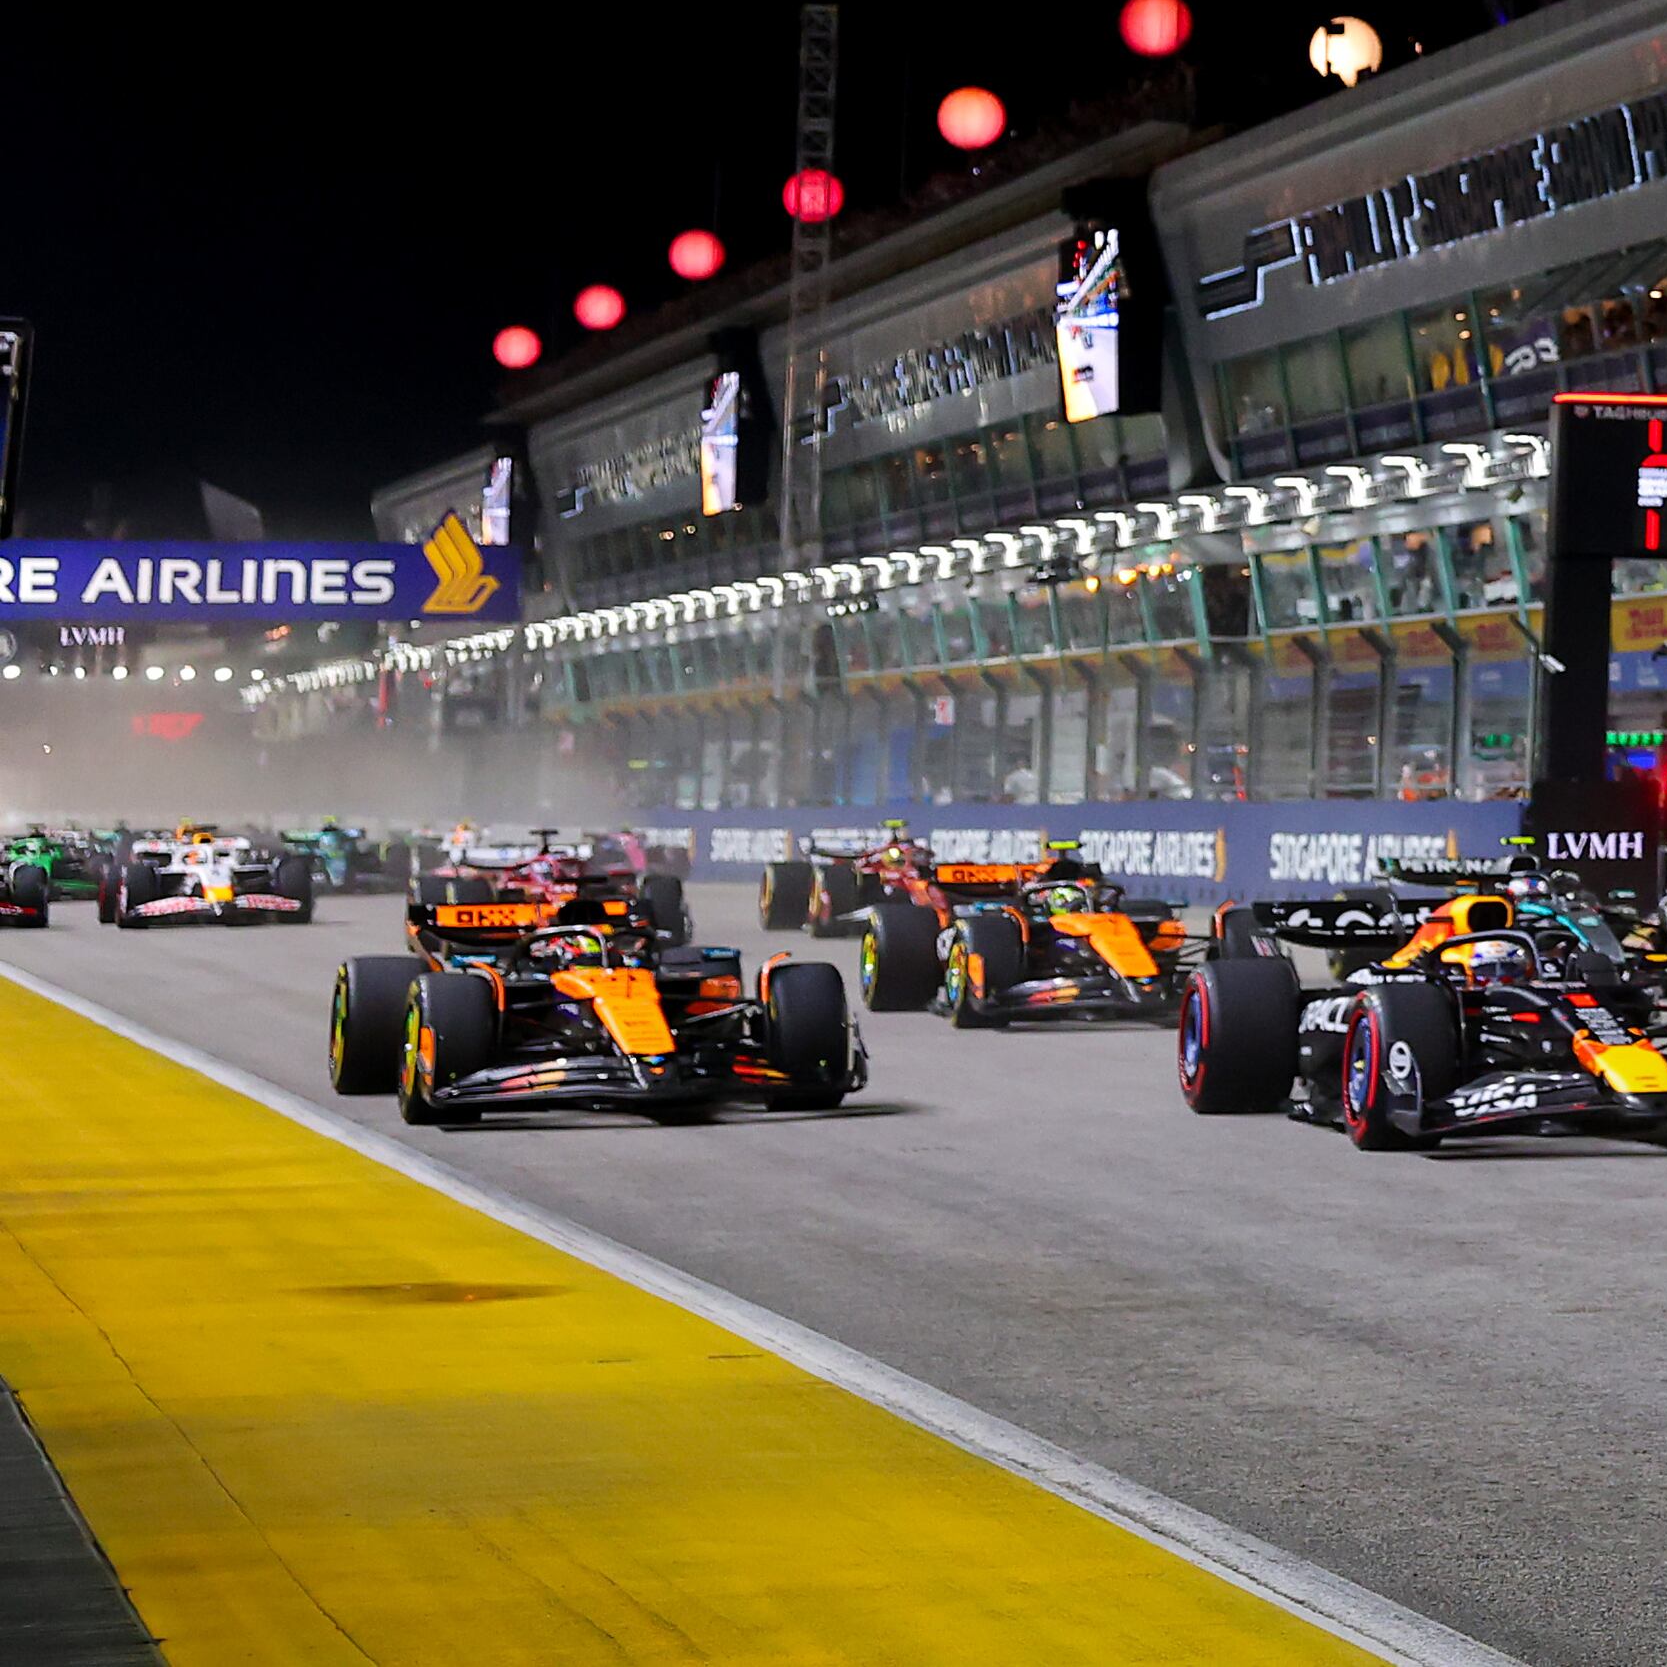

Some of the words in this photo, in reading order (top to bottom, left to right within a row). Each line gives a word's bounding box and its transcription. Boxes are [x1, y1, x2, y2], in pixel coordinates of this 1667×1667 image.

[81, 558, 395, 604] AIRLINES
[1269, 833, 1363, 884] SINGAPORE
[1547, 831, 1644, 861] LVMH
